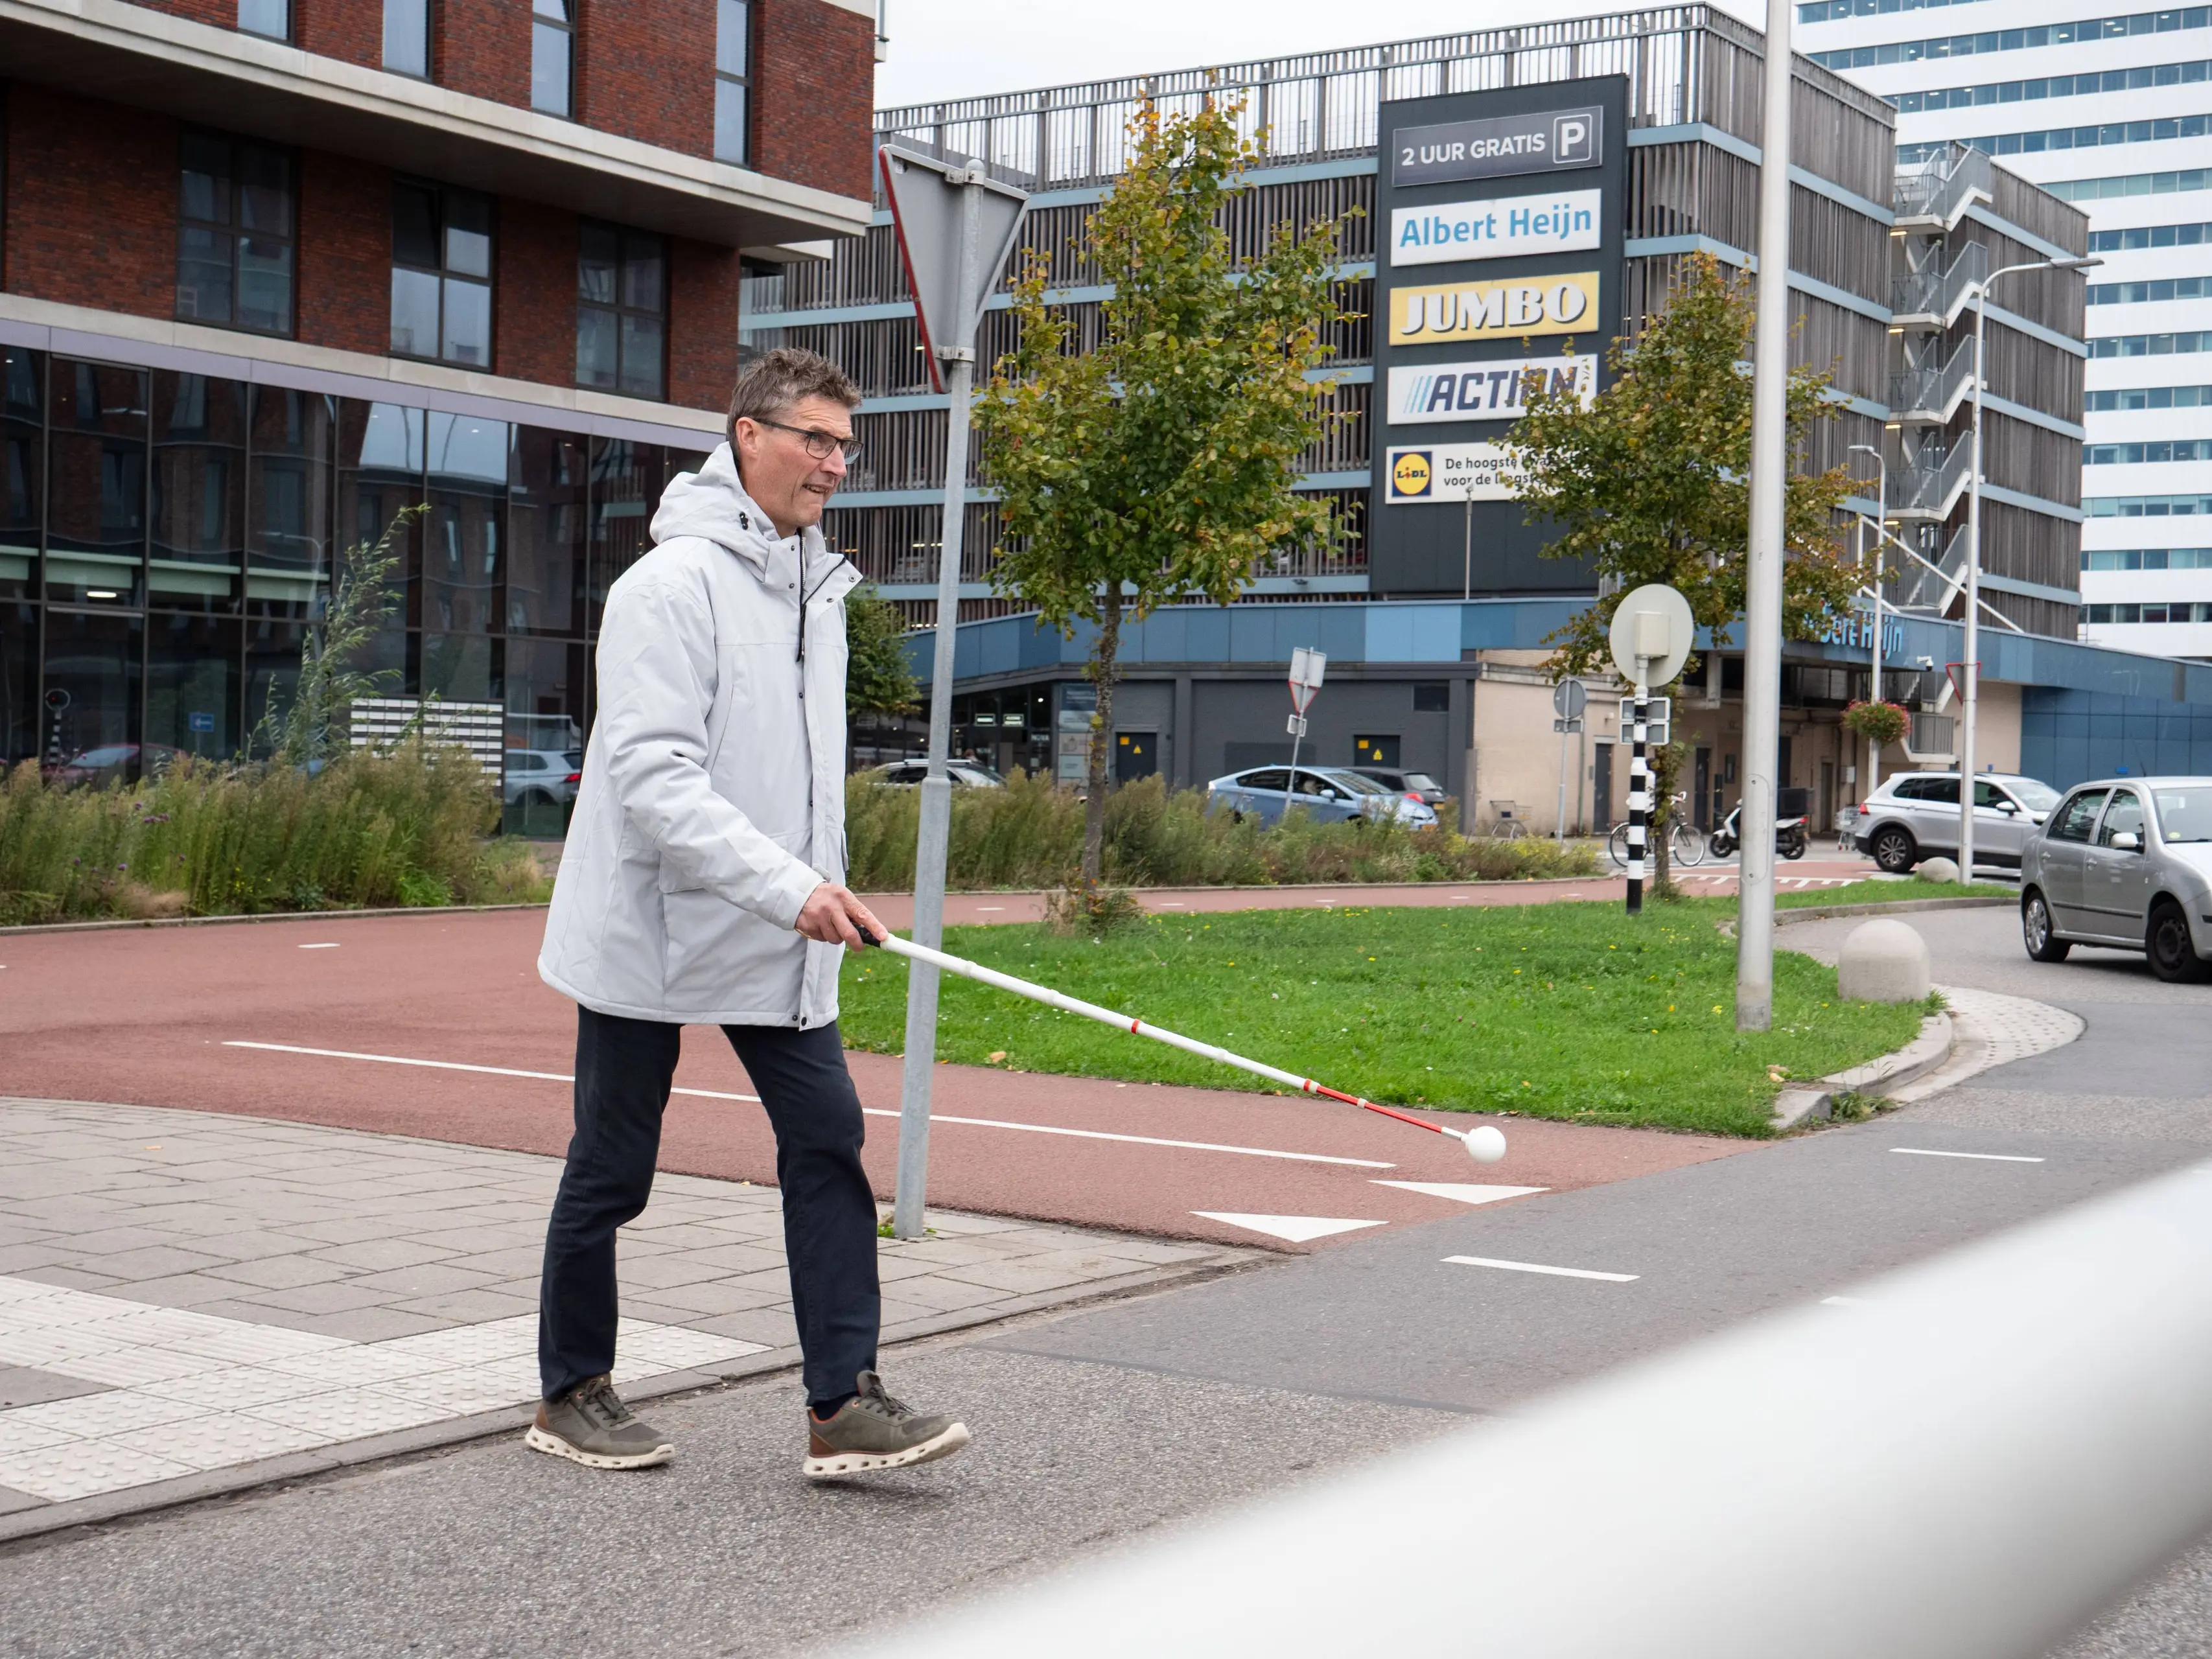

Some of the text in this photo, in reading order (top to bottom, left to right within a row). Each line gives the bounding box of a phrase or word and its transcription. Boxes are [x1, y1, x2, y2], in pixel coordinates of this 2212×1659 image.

[1401, 122, 1585, 166] 2 UUR GRATIS P
[1399, 203, 1591, 248] Albert Heijn
[1400, 282, 1587, 336] JUMBO
[1444, 476, 1473, 486] voor
[1476, 474, 1491, 485] de
[1445, 458, 1462, 470] De
[1465, 457, 1517, 470] hoogste
[1860, 611, 1903, 661] Hijn
